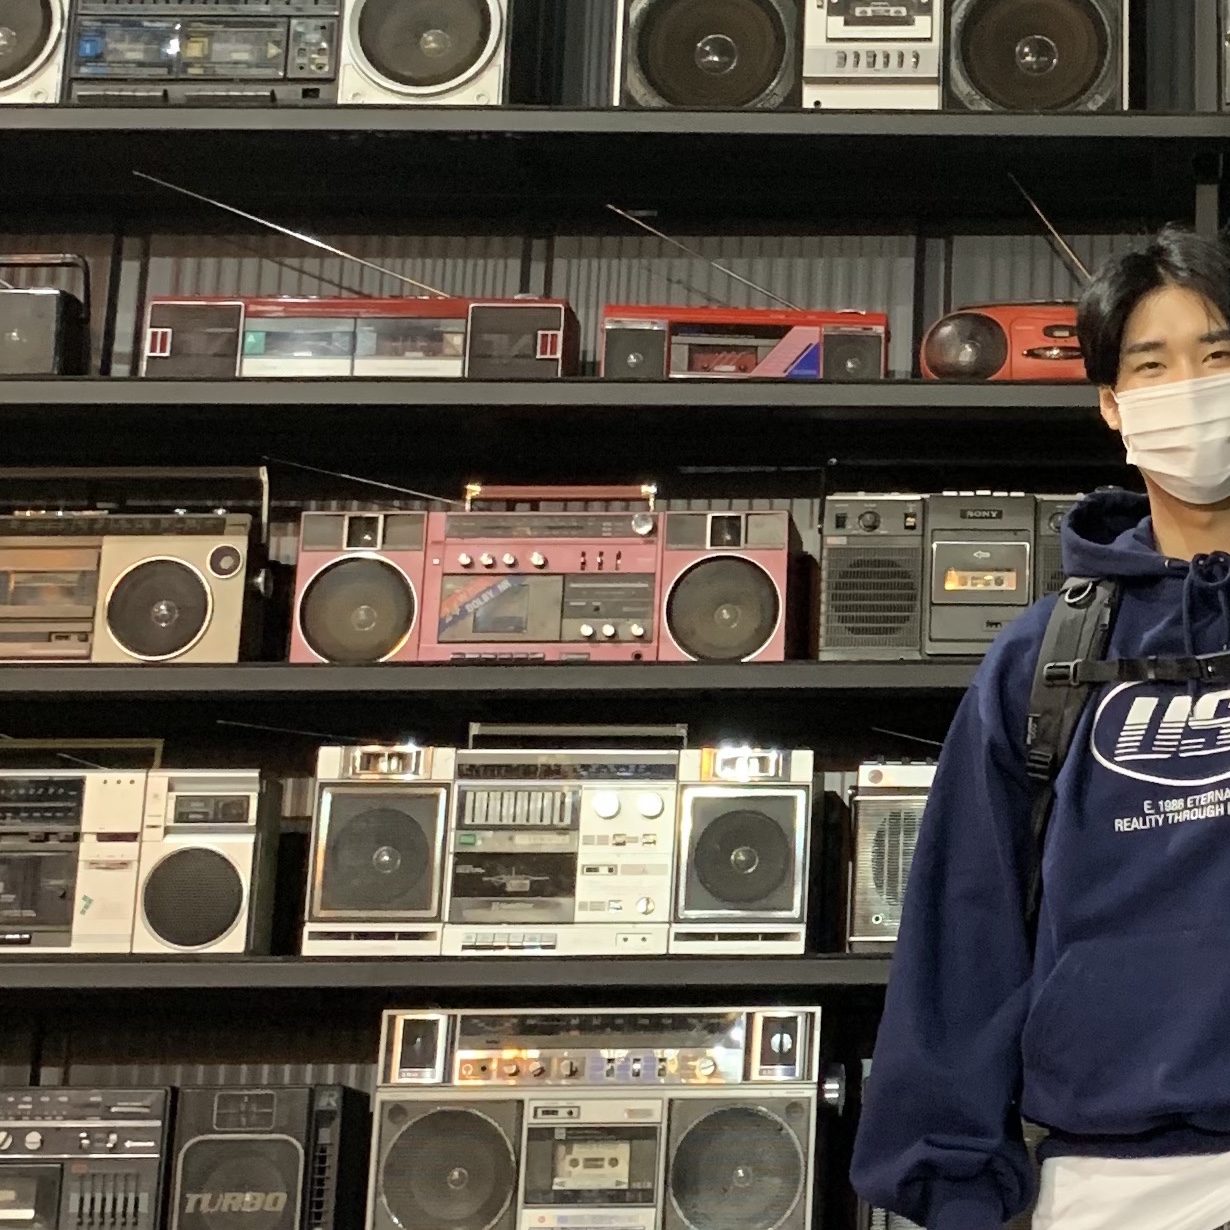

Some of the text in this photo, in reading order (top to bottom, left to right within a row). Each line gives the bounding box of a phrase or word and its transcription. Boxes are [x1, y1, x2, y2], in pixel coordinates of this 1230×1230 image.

[967, 510, 998, 519] SONY
[465, 589, 495, 613] DOLBY
[1114, 814, 1164, 832] REALITY
[1166, 804, 1225, 825] THROUGH
[184, 1191, 288, 1214] TURBO
